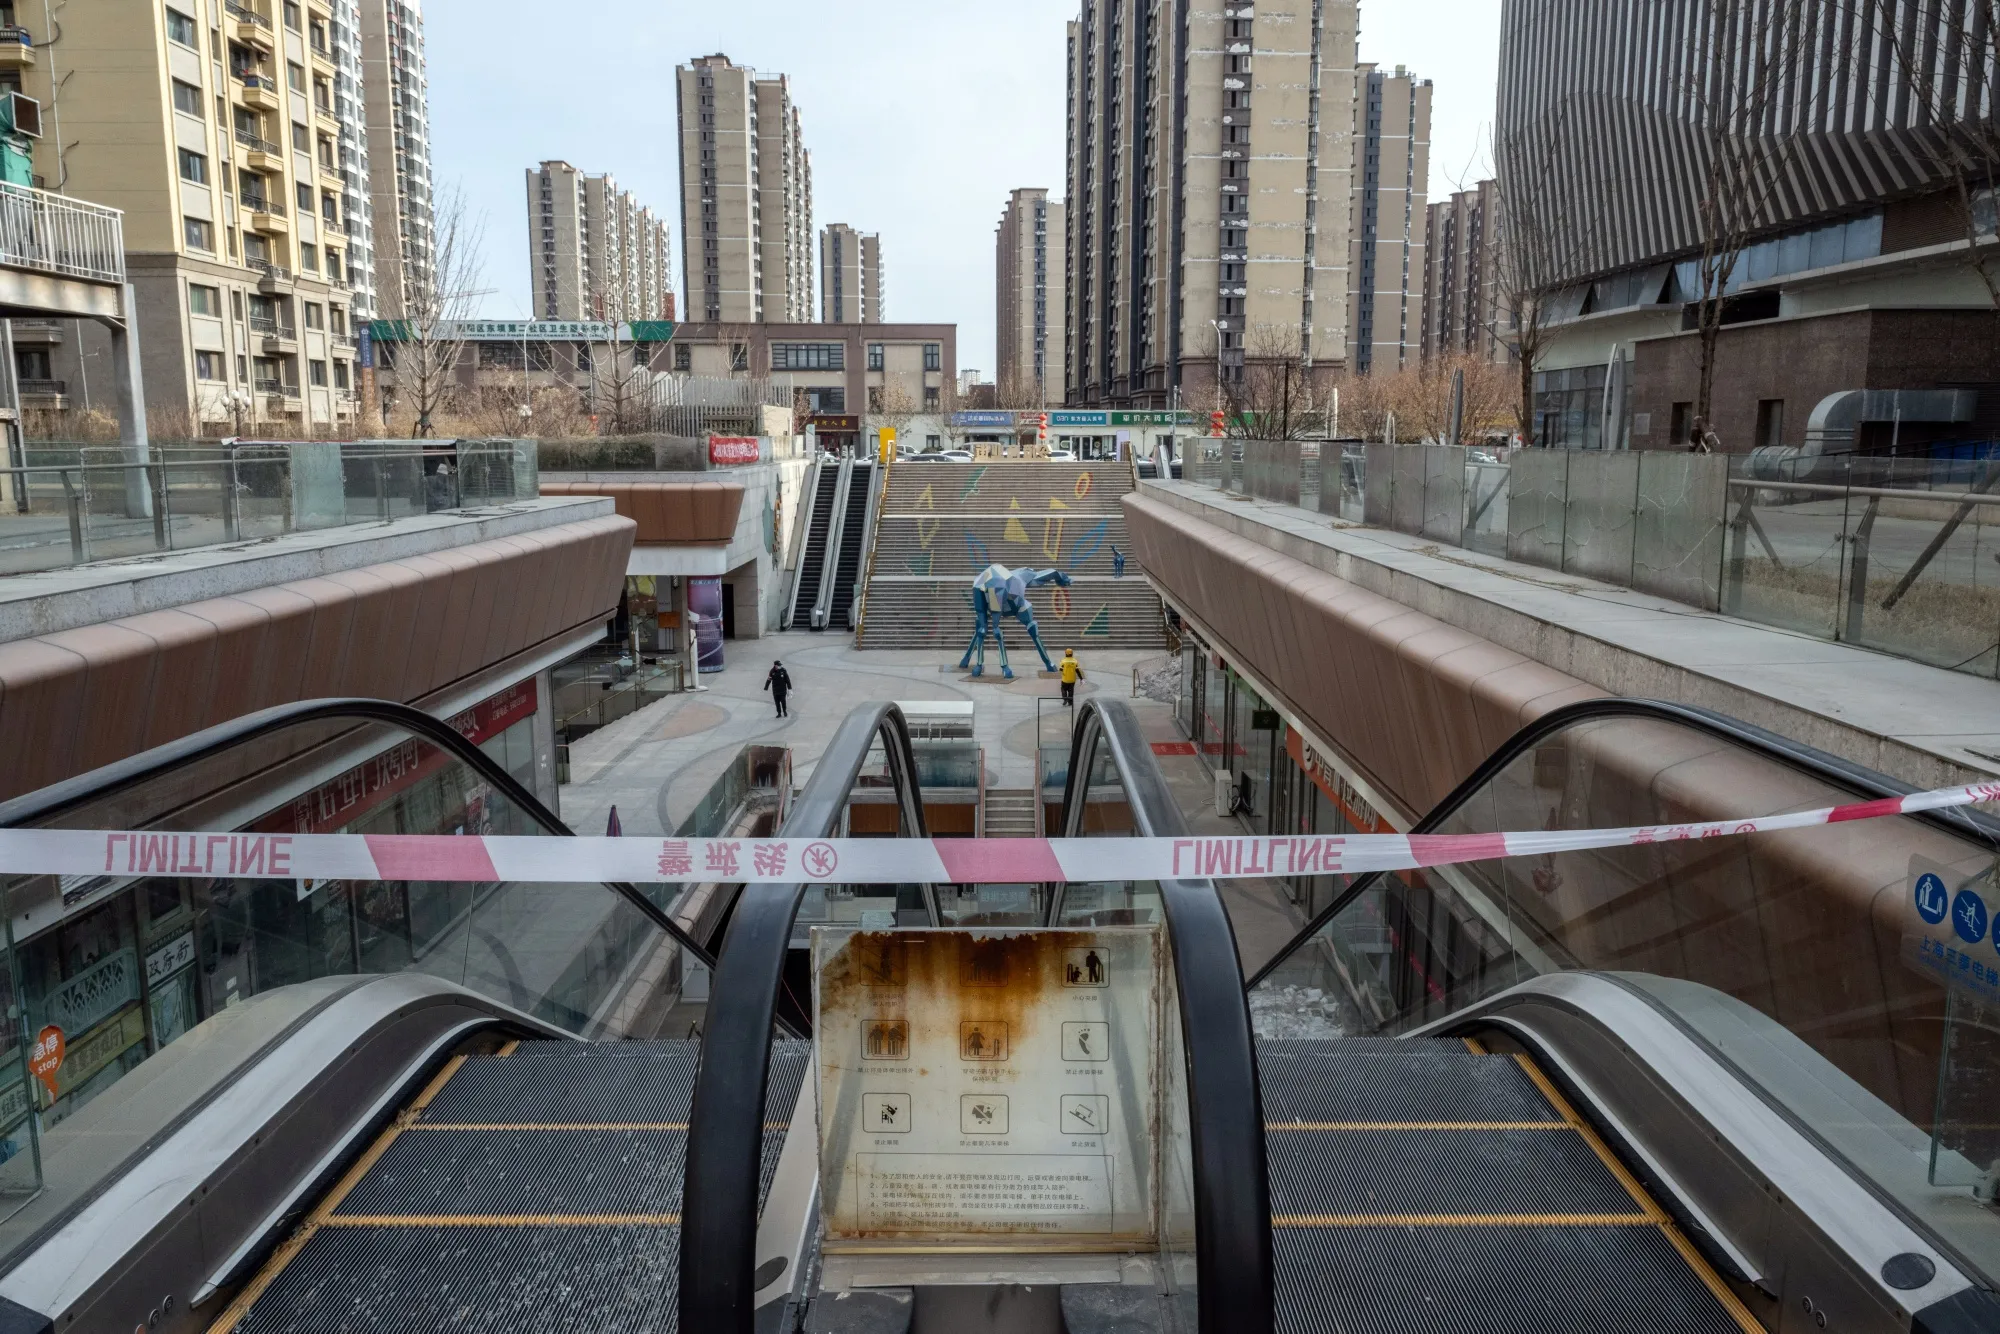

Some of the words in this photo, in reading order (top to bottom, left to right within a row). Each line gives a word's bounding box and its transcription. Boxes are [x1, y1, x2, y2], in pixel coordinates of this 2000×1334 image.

[149, 941, 190, 978] 政府街
[1920, 934, 1999, 986] 上海三菱电梯
[33, 1033, 59, 1062] 急停
[37, 1056, 58, 1075] stop
